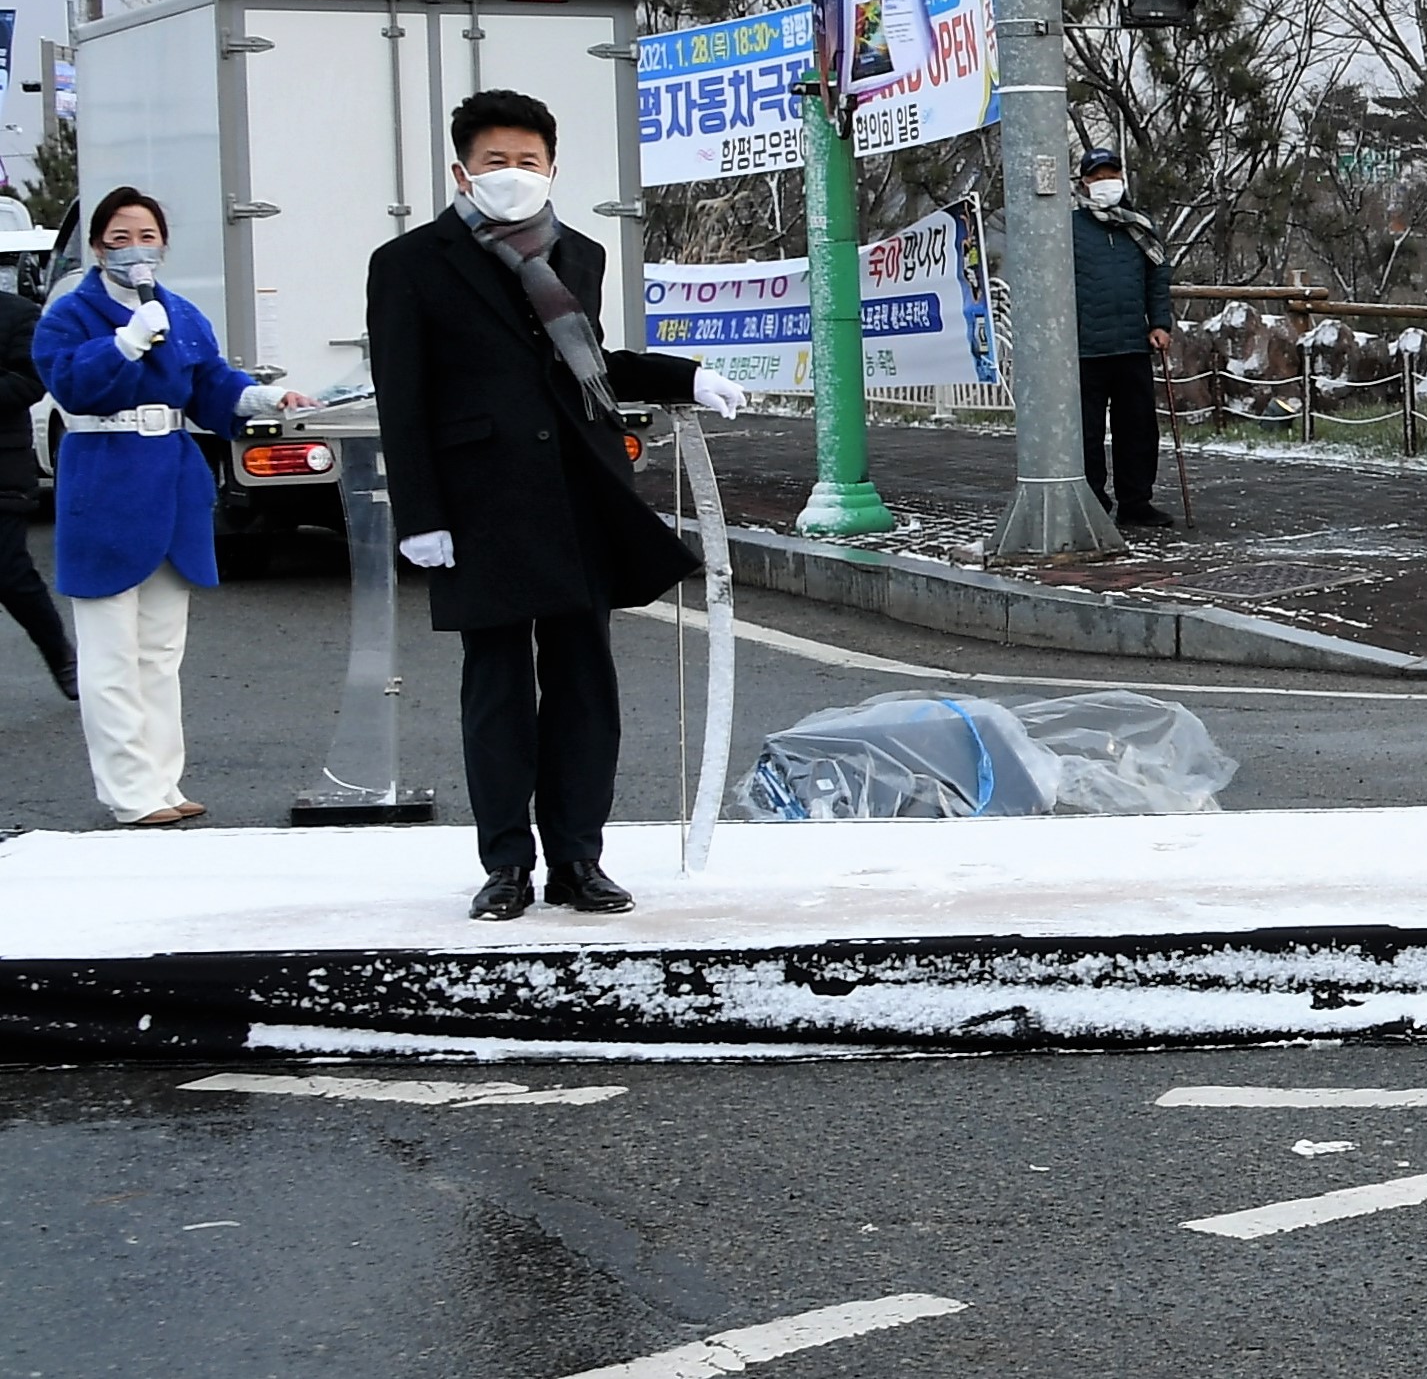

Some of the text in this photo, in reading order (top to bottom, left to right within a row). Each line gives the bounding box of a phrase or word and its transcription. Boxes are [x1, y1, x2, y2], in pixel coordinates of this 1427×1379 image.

[926, 9, 979, 87] OPEN
[896, 103, 920, 143] 일동
[695, 318, 726, 341] 2021.
